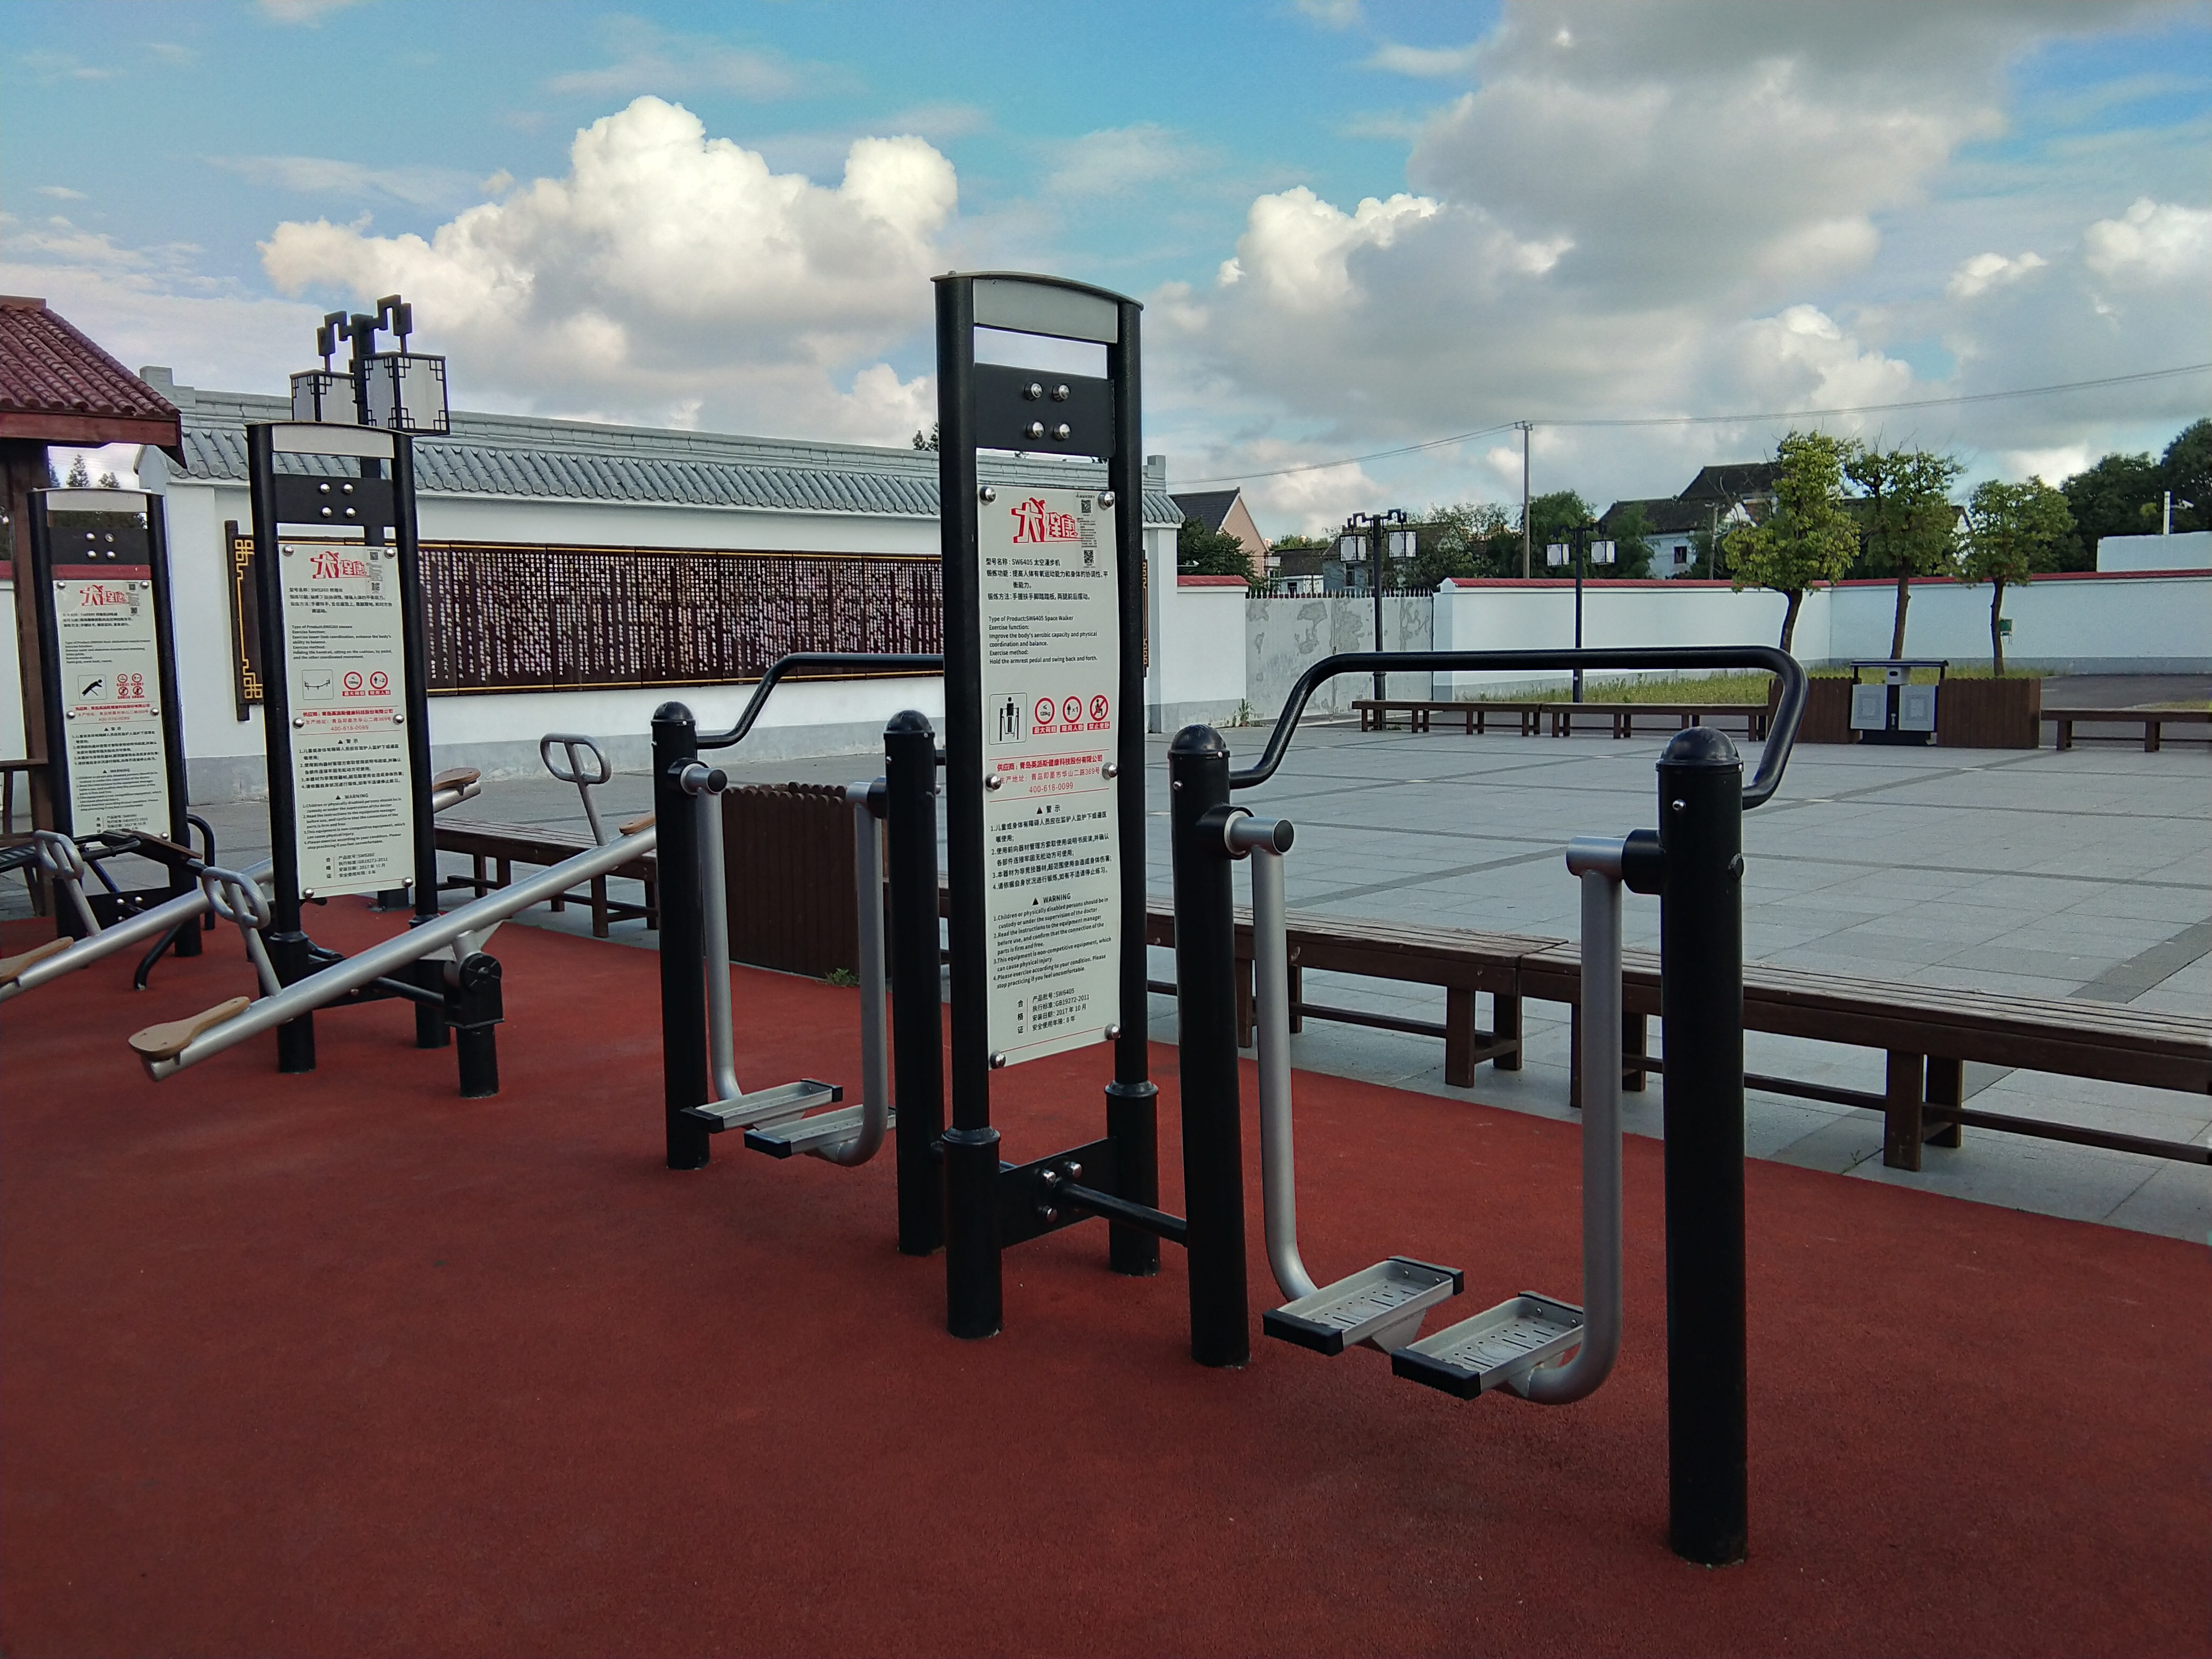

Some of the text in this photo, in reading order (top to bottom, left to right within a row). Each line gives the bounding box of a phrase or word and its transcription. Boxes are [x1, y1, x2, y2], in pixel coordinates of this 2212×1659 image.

[1029, 782, 1074, 793] 400-618-0099
[1043, 893, 1070, 903] WARNING
[1024, 907, 1046, 917] physically
[1046, 903, 1065, 912] disabled
[1044, 912, 1070, 921] supervision
[1018, 925, 1045, 934] instructions
[1059, 918, 1082, 927] equipment
[1068, 925, 1091, 933] connection
[1007, 952, 1032, 961] equipment
[1037, 944, 1073, 955] non-competitive
[1074, 940, 1098, 948] equipment,
[1019, 959, 1038, 968] physical
[1032, 965, 1053, 973] according
[1007, 978, 1030, 987] practicing
[1052, 966, 1085, 977] uncomfortable.
